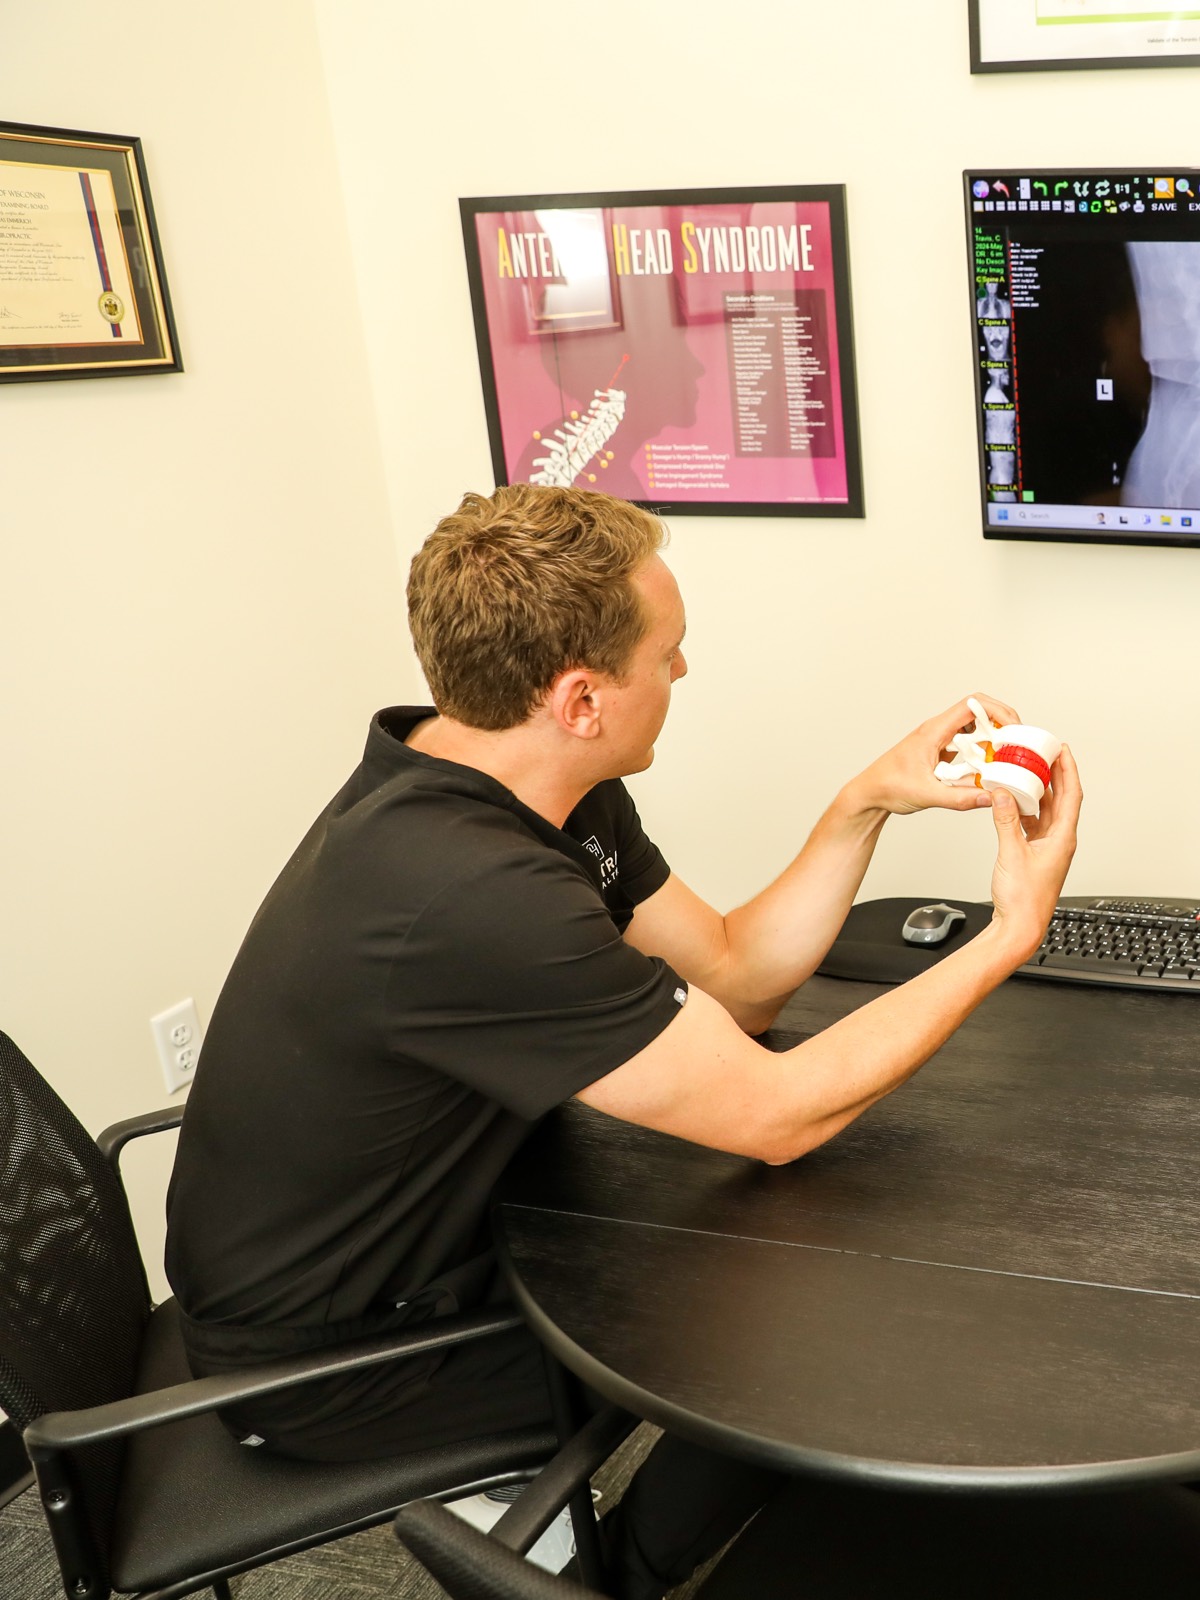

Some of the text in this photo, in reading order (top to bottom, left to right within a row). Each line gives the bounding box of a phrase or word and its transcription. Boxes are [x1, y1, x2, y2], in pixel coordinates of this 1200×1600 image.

[1114, 183, 1130, 194] 1:1
[8, 190, 45, 199] WISCONSIN
[1151, 203, 1178, 211] SAVE
[612, 224, 673, 276] HEAD
[681, 221, 814, 274] SYNDROME
[976, 267, 988, 275] Key
[1101, 384, 1109, 395] L
